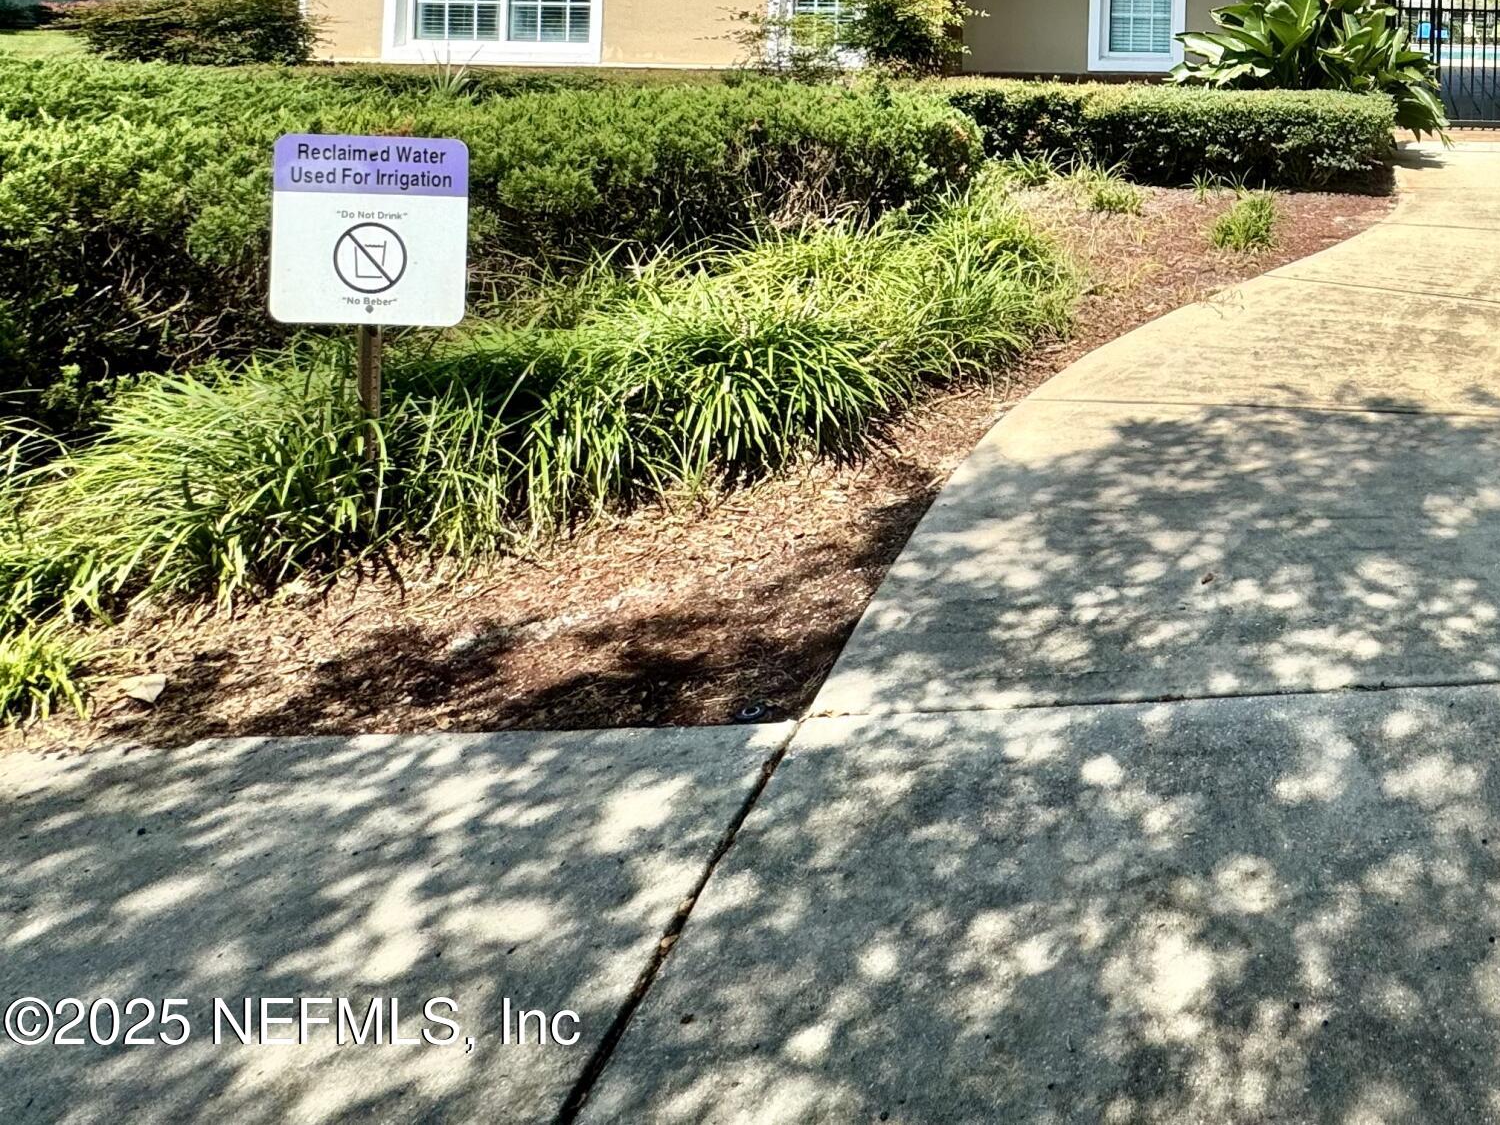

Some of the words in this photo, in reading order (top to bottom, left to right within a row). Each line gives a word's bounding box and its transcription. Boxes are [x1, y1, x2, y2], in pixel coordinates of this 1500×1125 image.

[297, 143, 391, 163] Reclaimed
[396, 145, 447, 164] Water
[290, 166, 336, 184] Used
[341, 168, 371, 185] For
[376, 169, 453, 191] Irrigation
[357, 210, 375, 219] Not
